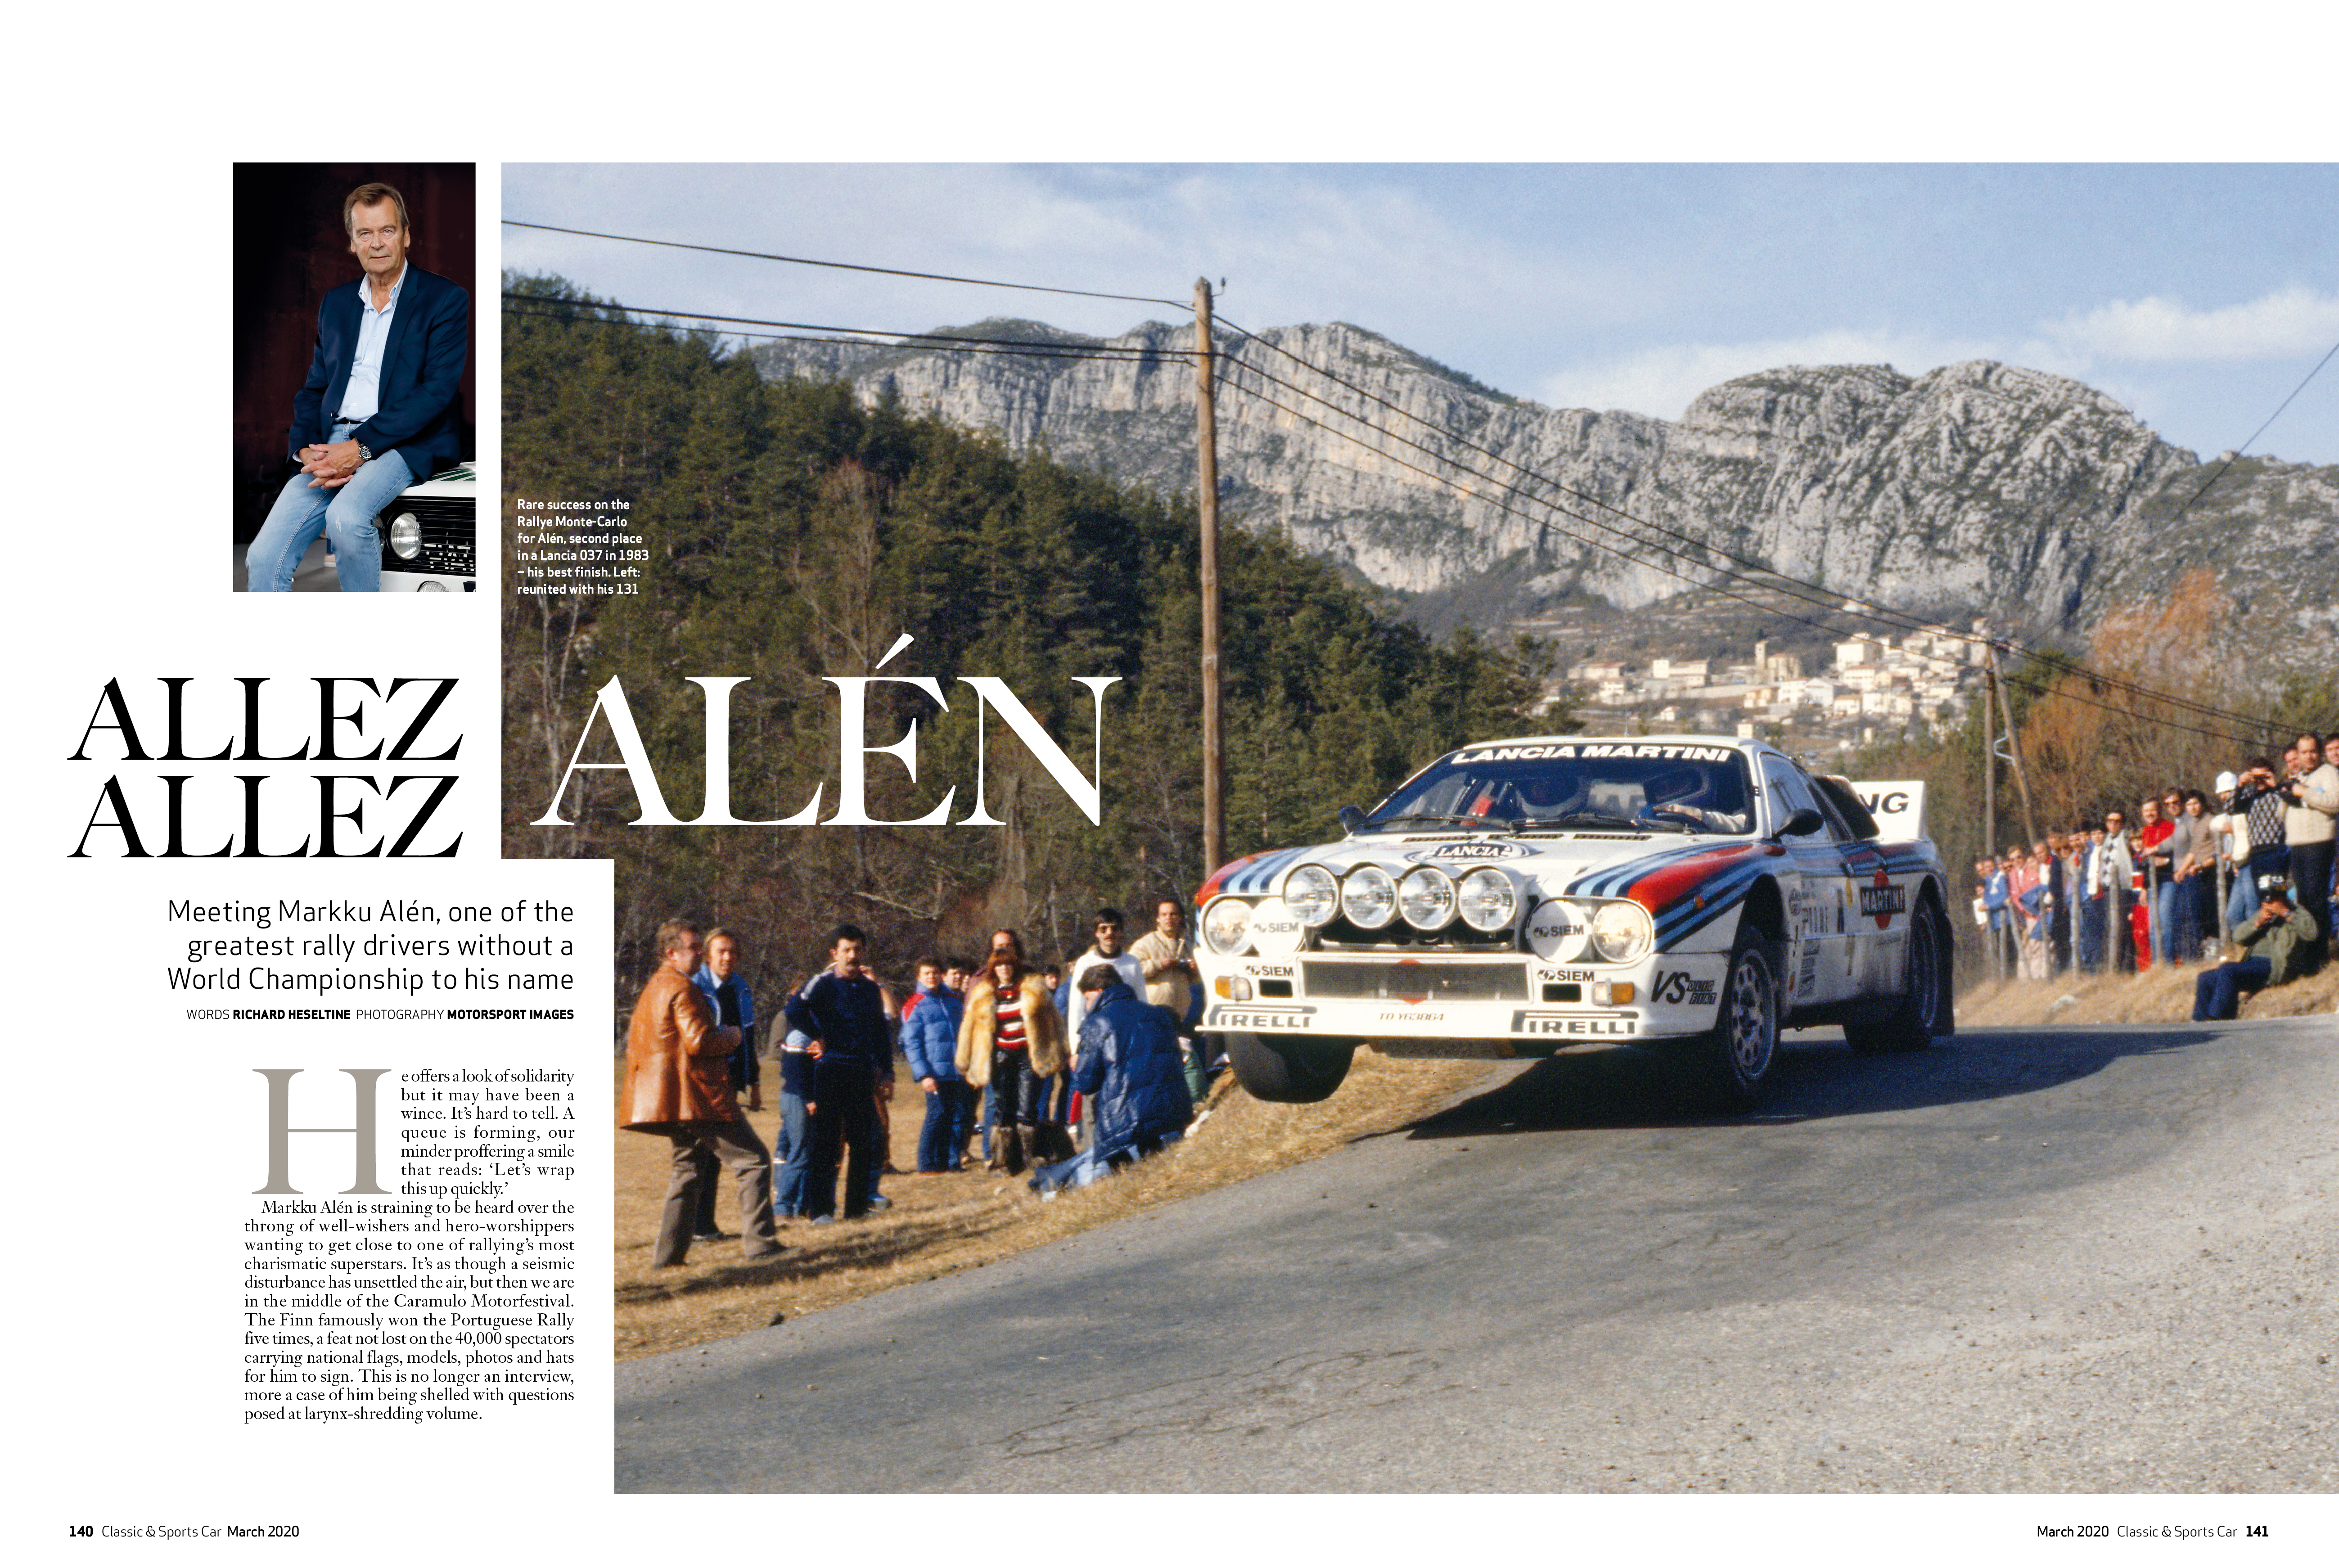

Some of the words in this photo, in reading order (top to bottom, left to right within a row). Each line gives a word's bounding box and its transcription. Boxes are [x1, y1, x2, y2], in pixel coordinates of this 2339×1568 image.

[1451, 746, 1575, 765] LANCIA
[1581, 745, 1731, 762] MARTINI
[1438, 846, 1500, 857] LANCIA
[1861, 889, 1903, 912] MARTINI
[1269, 922, 1299, 933] SIEM
[1550, 924, 1584, 937] SIEM
[1262, 966, 1294, 977] SIEM
[1557, 970, 1595, 982] SIEM
[1650, 971, 1690, 1004] VS
[1690, 992, 1717, 1005] FIAT
[1208, 1004, 1318, 1028] PIRELLI
[1511, 1009, 1640, 1035] PIRELLI
